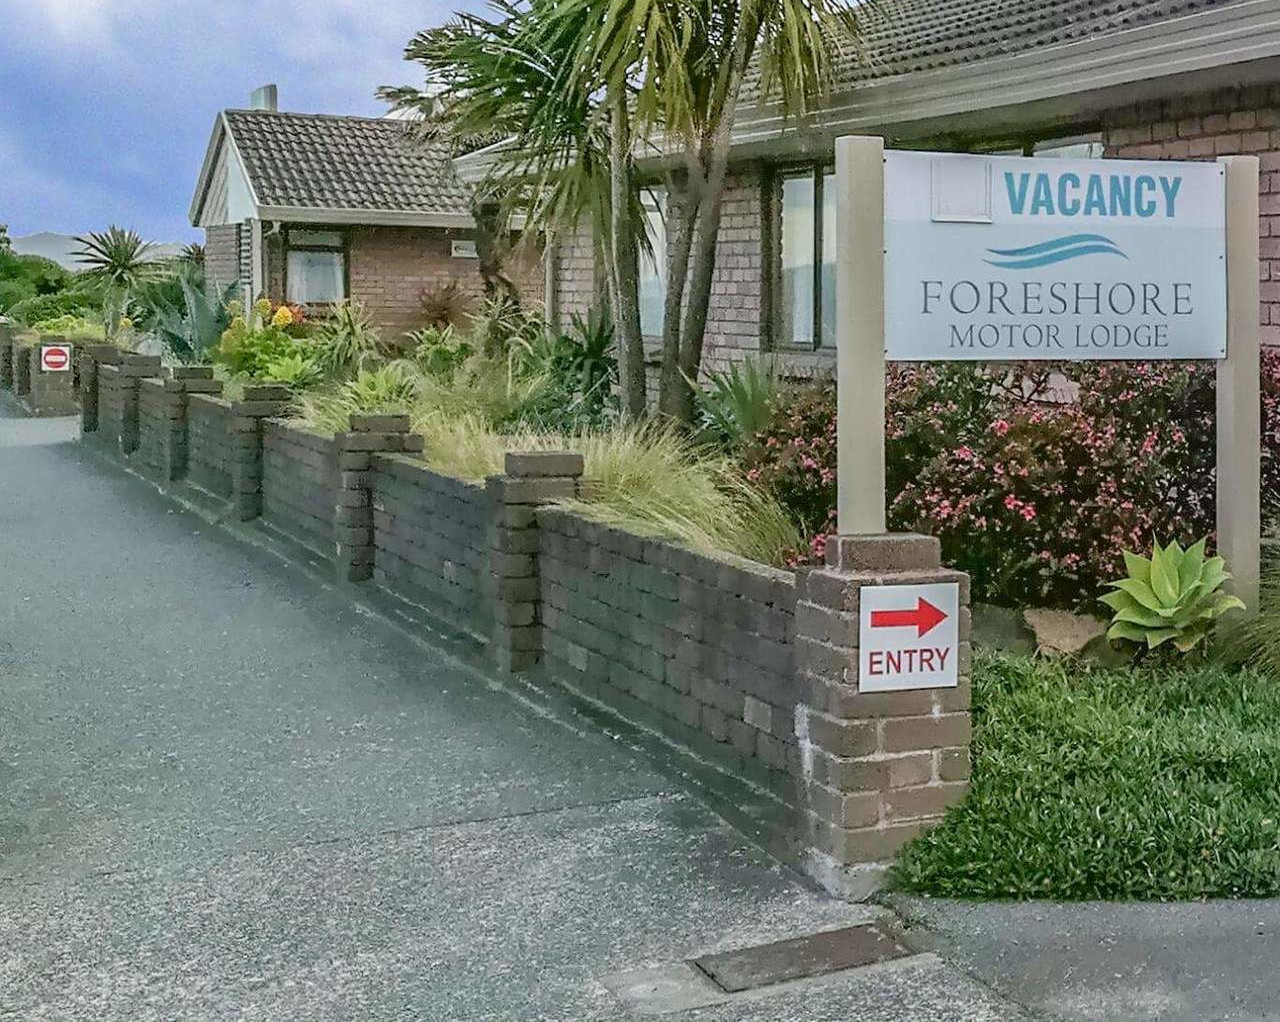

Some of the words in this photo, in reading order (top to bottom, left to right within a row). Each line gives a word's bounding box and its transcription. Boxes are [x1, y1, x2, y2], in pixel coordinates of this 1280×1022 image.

[1004, 172, 1182, 218] VACANCY
[921, 280, 1193, 316] FORESHORE
[948, 323, 1065, 349] MOTOR
[1075, 324, 1169, 349] LODGE
[868, 646, 950, 676] ENTRY
